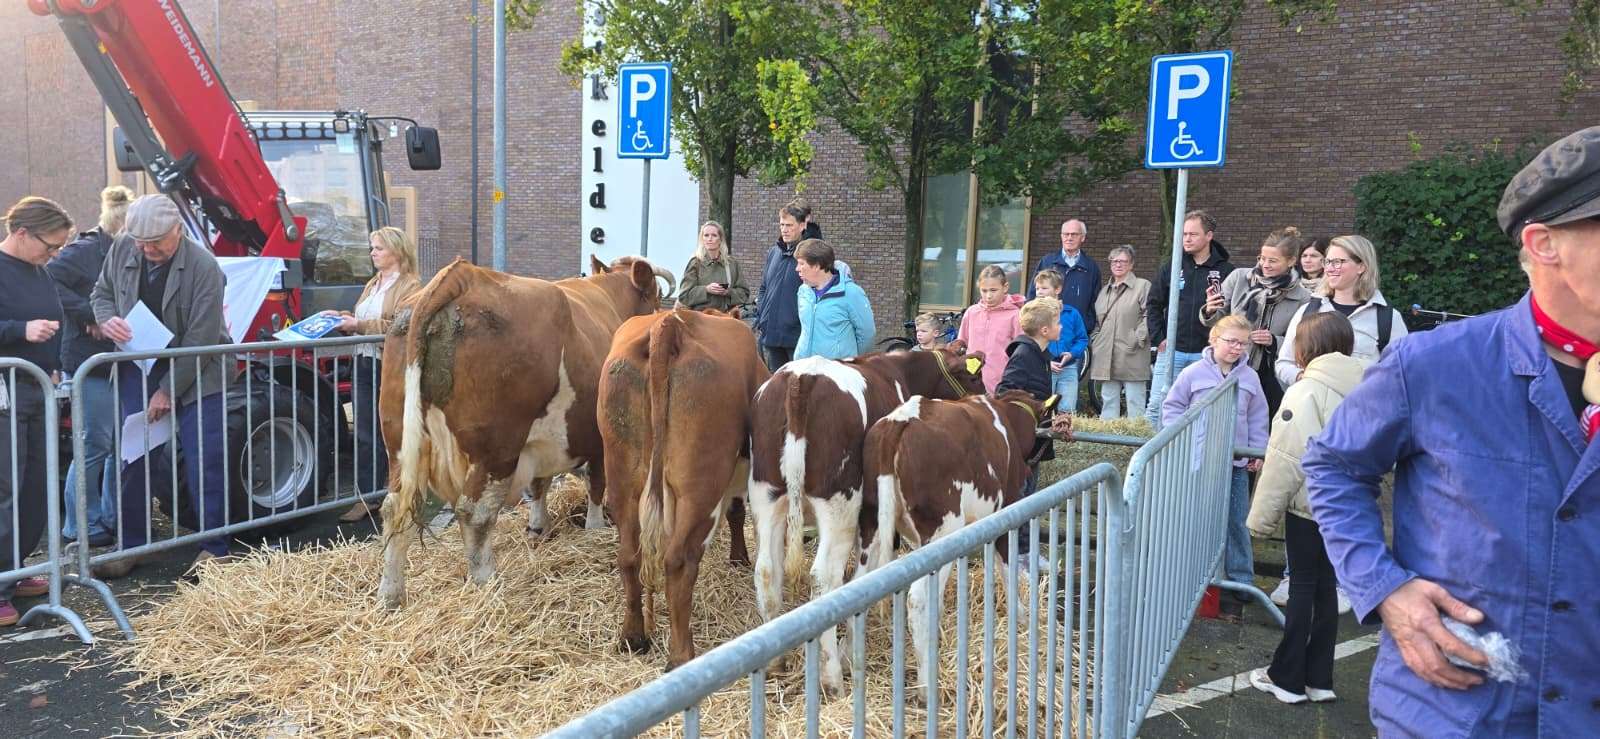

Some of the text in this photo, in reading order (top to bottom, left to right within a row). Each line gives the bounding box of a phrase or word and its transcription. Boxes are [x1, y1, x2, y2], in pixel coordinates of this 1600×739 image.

[158, 0, 214, 87] WEIDEMANN
[630, 74, 657, 118] P
[1167, 64, 1210, 120] P
